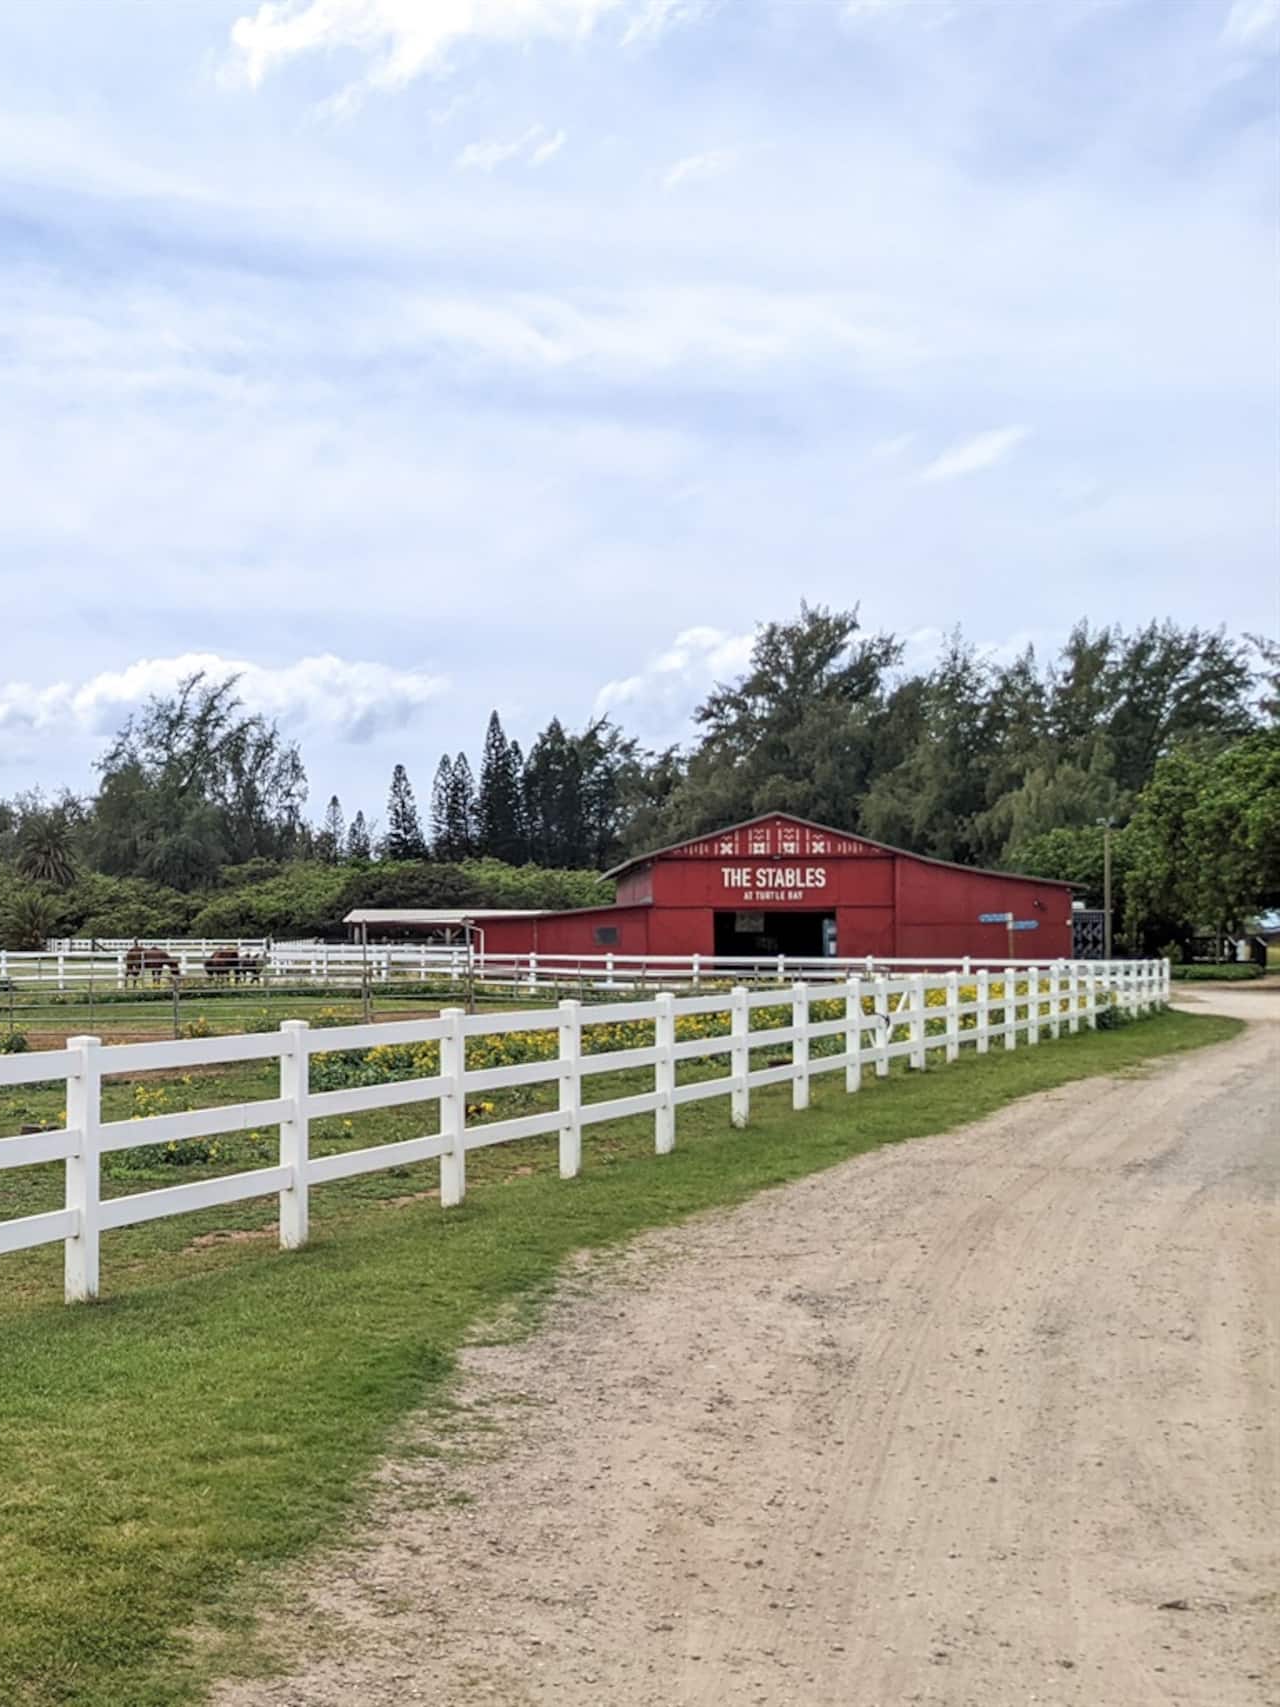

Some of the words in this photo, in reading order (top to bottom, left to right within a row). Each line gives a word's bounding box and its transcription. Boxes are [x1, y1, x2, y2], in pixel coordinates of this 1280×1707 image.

[721, 867, 752, 888] THE
[755, 867, 826, 888] STABLES
[743, 891, 753, 900] AT
[755, 891, 785, 900] TURTLE
[787, 891, 803, 900] BAY
